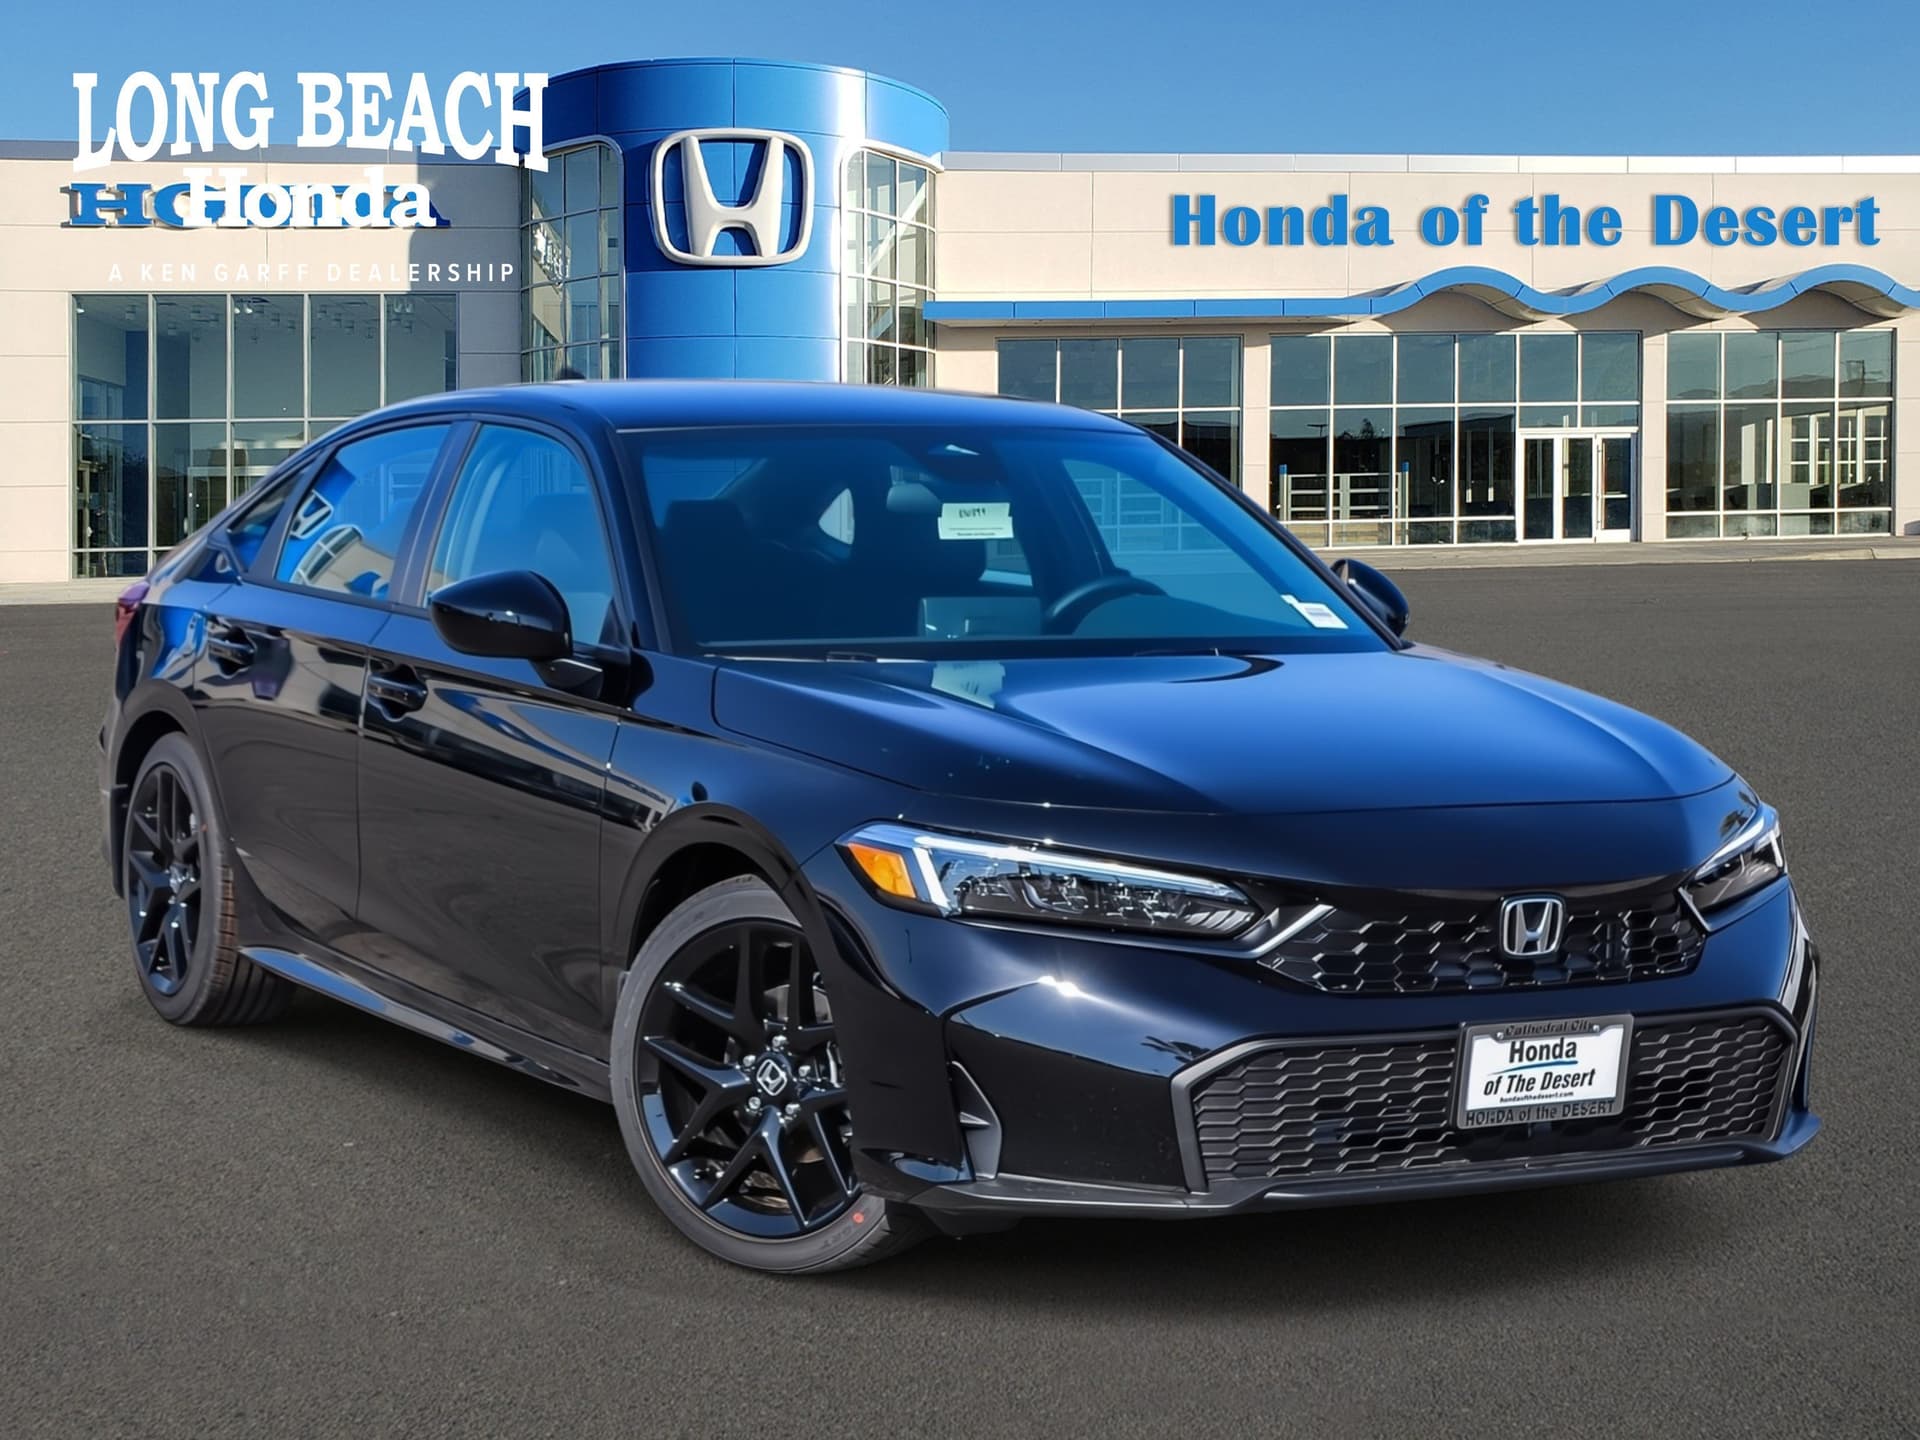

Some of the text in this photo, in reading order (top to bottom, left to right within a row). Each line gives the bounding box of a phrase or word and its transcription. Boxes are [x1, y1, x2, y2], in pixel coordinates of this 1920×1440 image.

[1170, 193, 1881, 246] Honda of the Desert
[1509, 1037, 1577, 1063] Honda
[1483, 1068, 1596, 1095] of The Desert
[1466, 1100, 1615, 1126] HONDA of the DESERT
